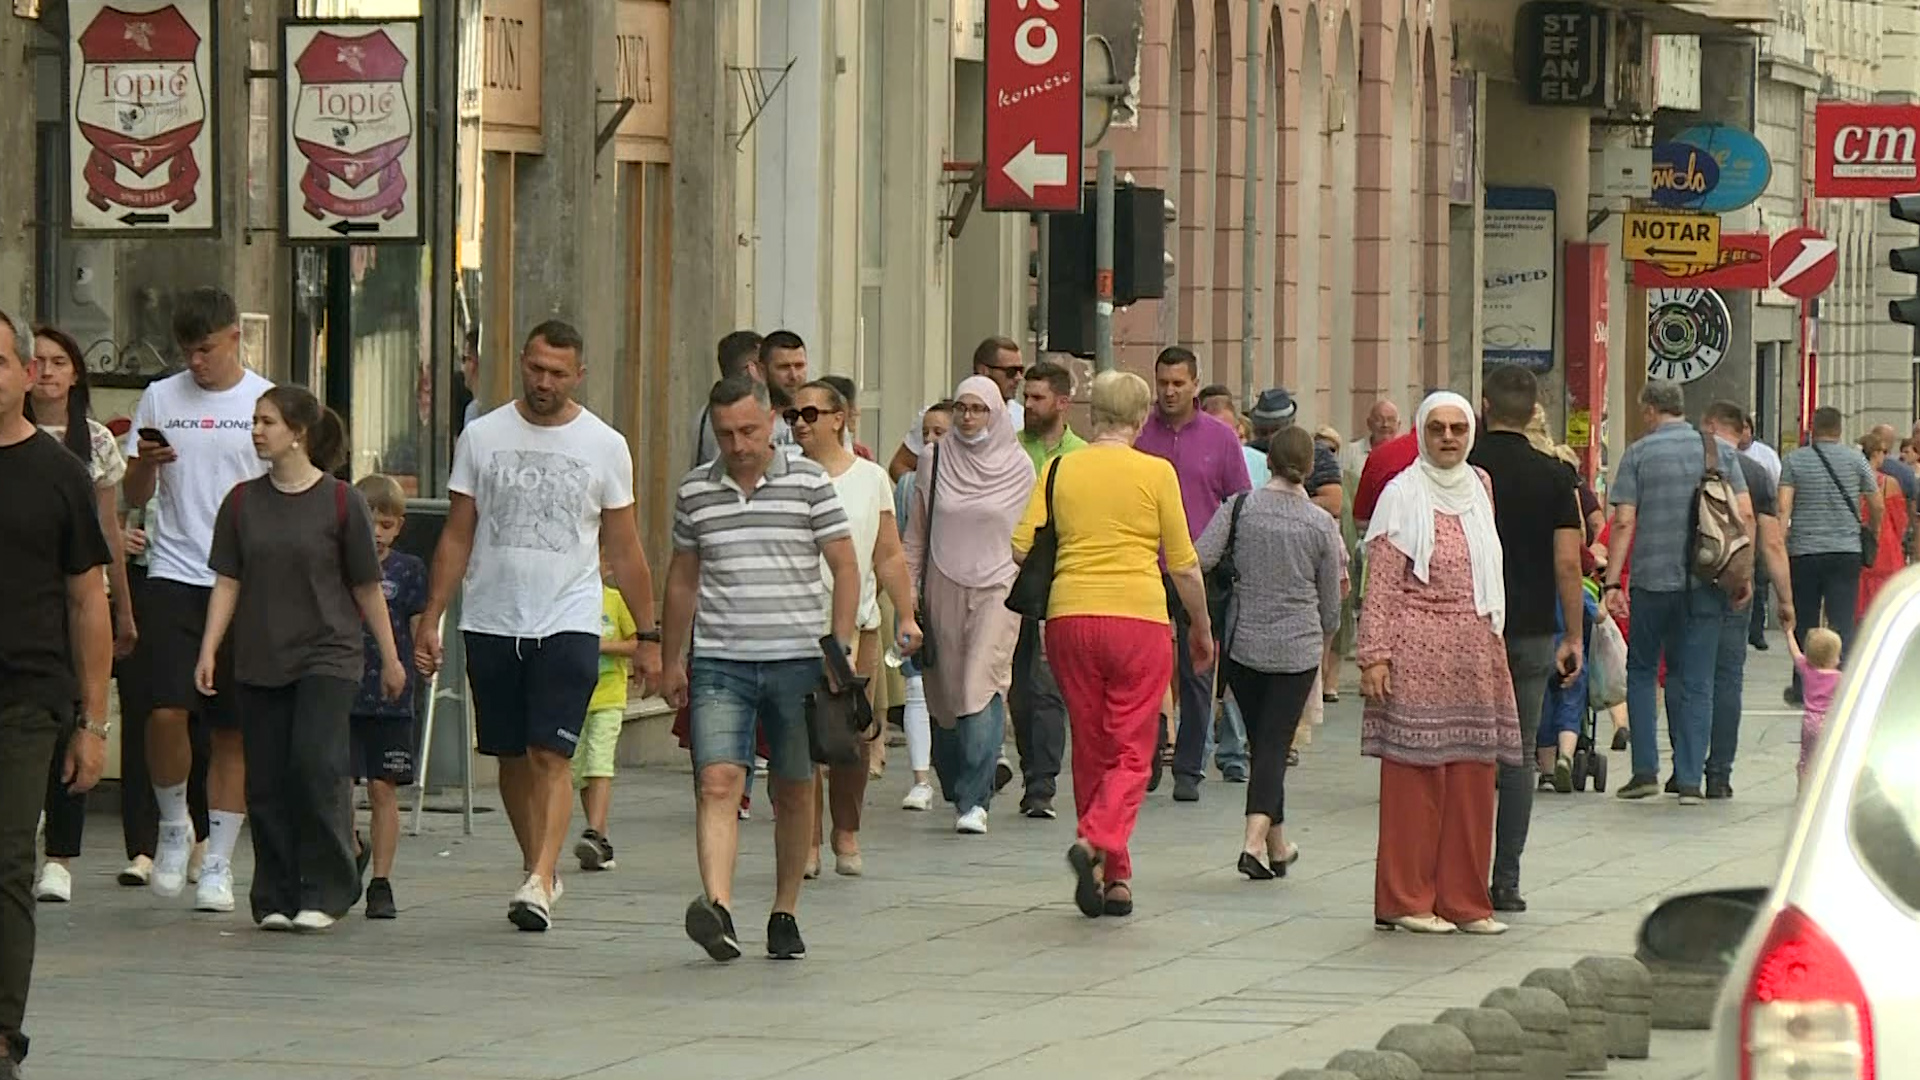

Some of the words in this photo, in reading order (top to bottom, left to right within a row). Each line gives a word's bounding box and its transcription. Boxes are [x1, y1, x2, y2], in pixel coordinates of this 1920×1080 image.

[1833, 124, 1917, 164] cm
[1632, 219, 1711, 242] NOTAR
[164, 418, 199, 429] JACK
